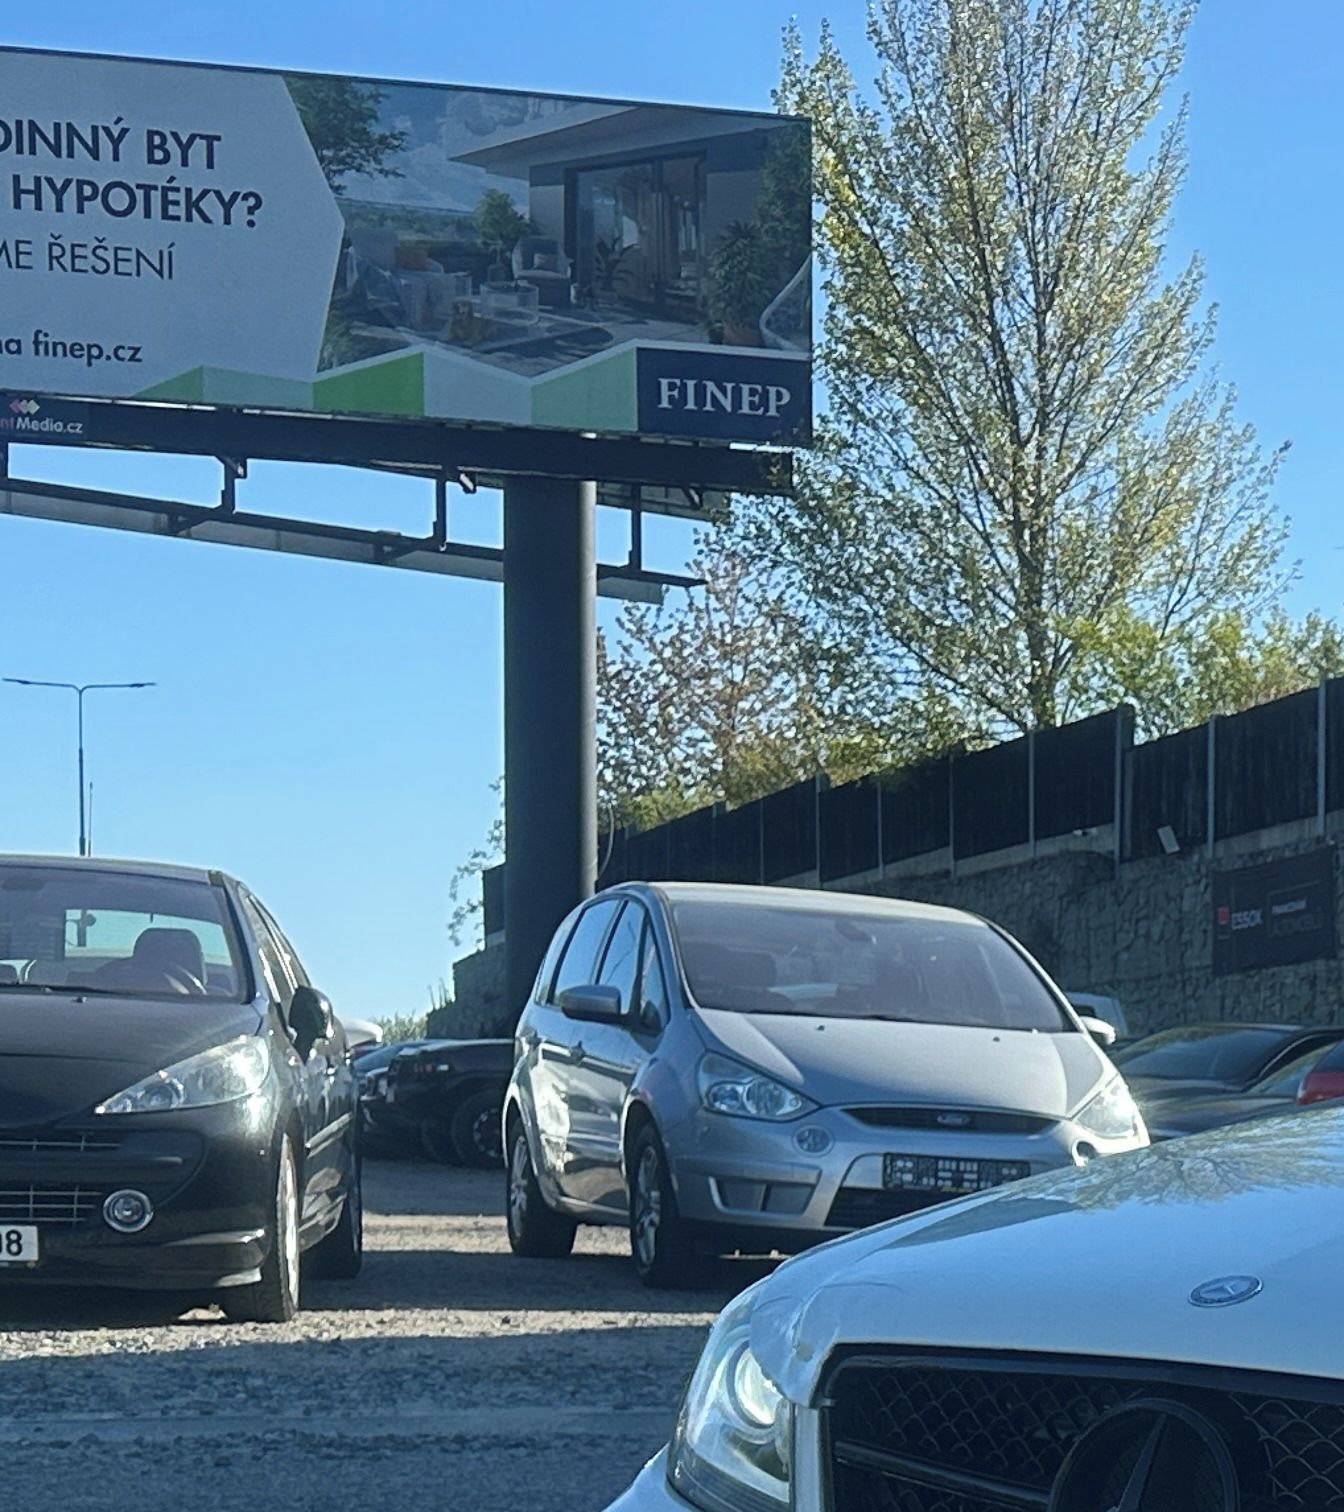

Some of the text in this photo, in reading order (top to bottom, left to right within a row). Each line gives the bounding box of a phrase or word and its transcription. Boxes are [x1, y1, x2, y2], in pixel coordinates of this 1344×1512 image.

[147, 129, 221, 170] BYT
[12, 175, 263, 228] HYPOTÉKY?
[48, 233, 175, 281] ŘEŠENÍ
[0, 329, 143, 367] a finep.cz
[657, 378, 791, 417] FINEP
[0, 1229, 23, 1256] 8
